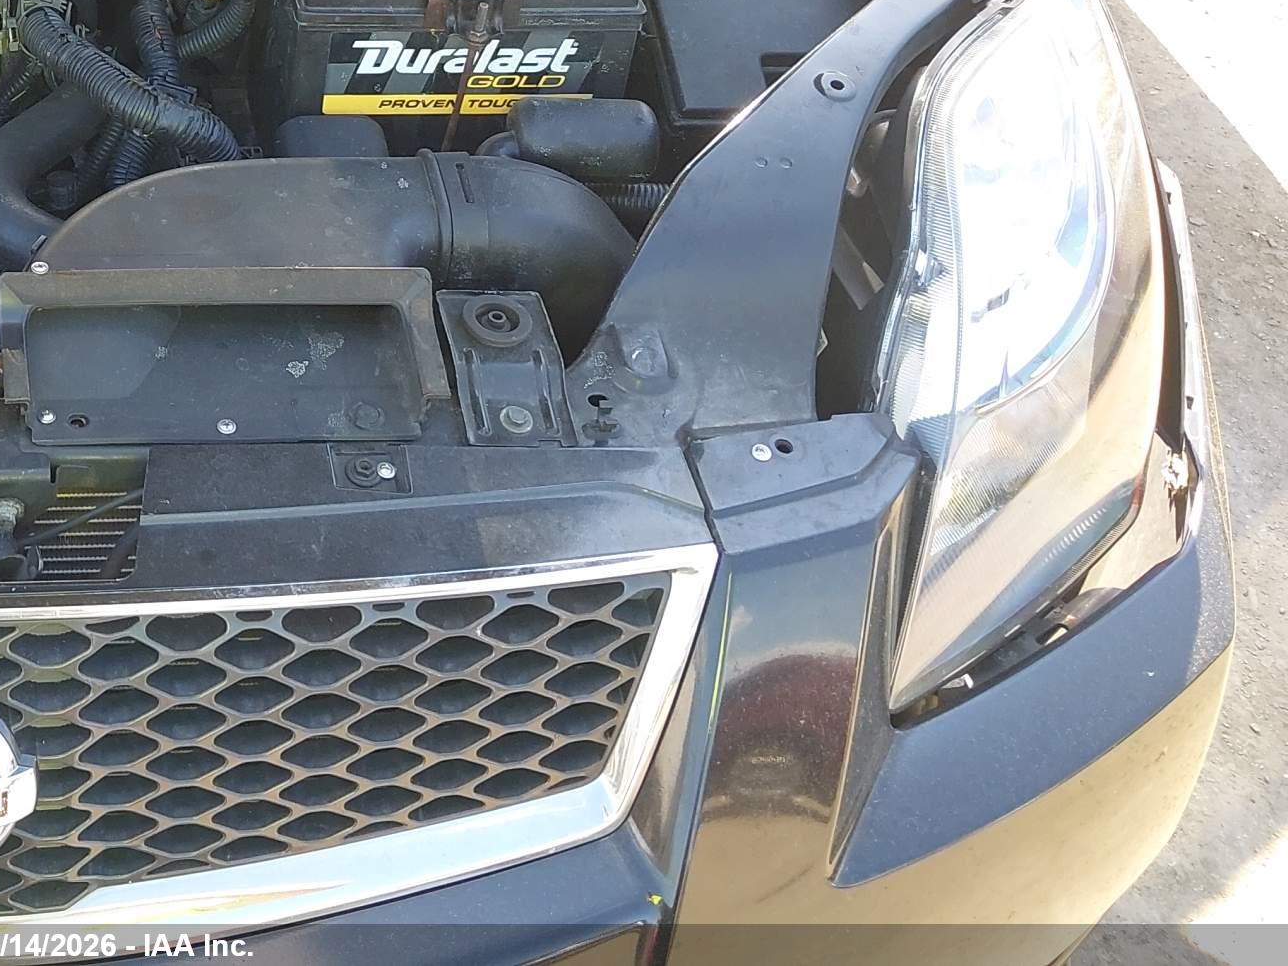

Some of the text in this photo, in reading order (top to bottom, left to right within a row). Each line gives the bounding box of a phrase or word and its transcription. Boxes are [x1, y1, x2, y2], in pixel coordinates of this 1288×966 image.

[352, 38, 579, 74] Duralast
[466, 75, 566, 88] GOLD
[378, 99, 456, 109] PROVEN
